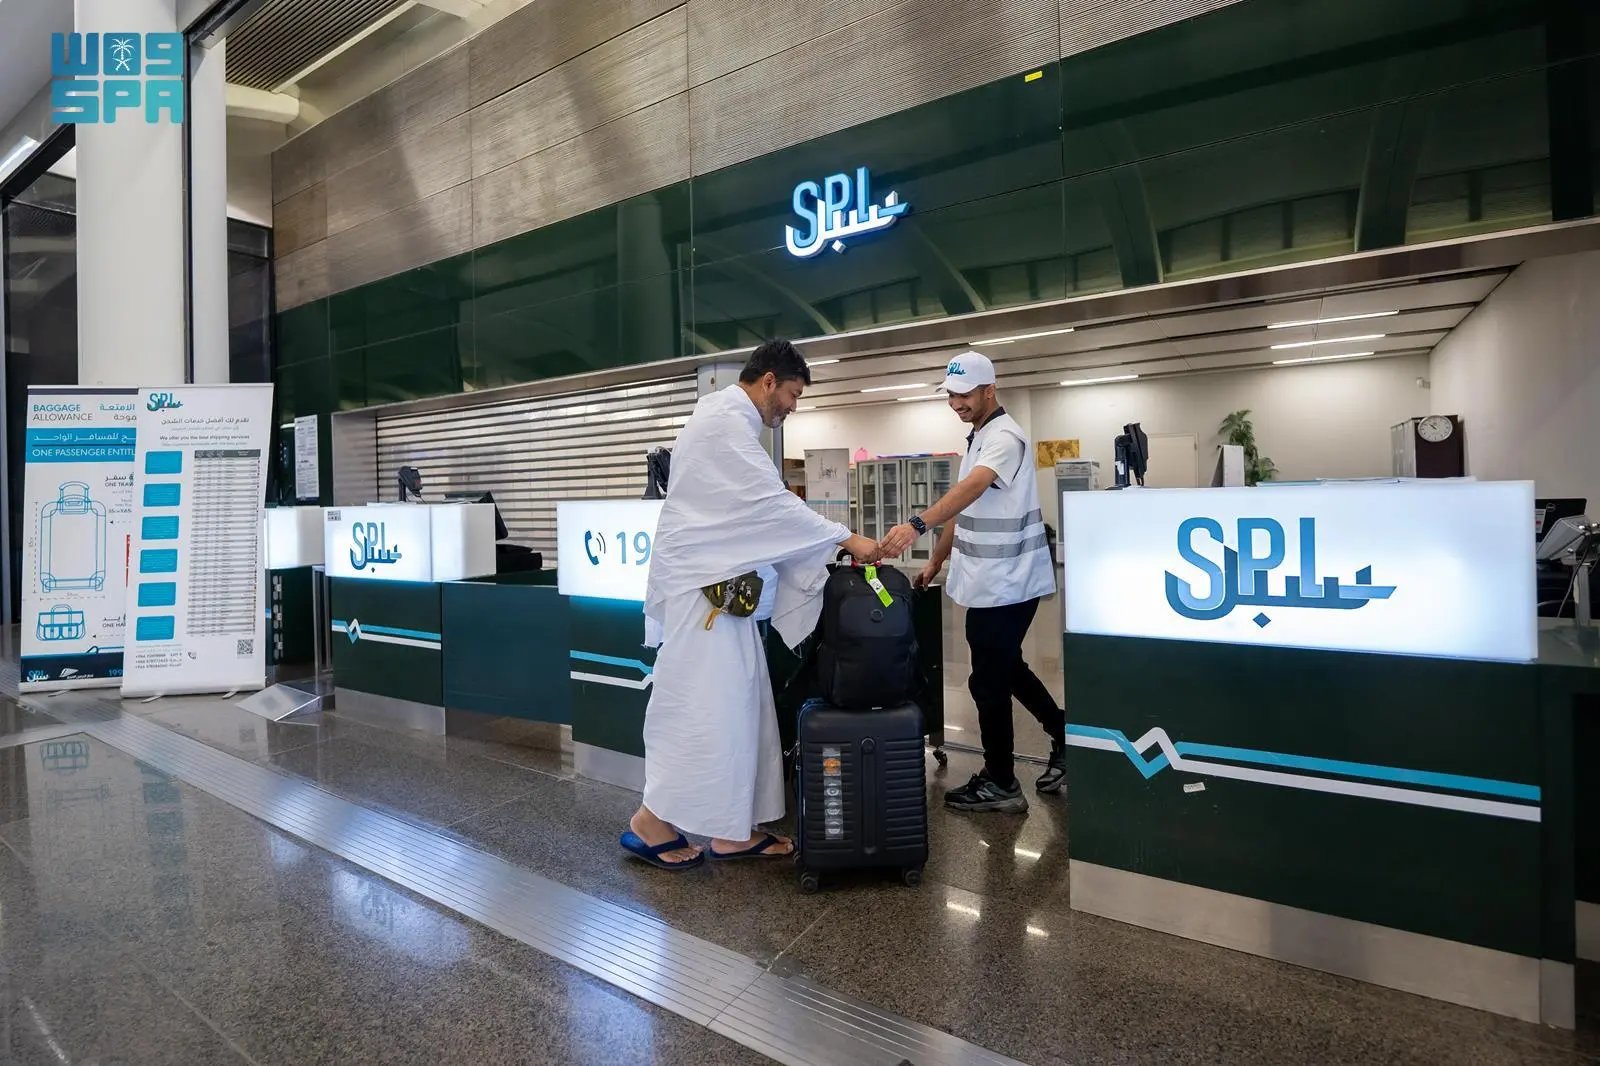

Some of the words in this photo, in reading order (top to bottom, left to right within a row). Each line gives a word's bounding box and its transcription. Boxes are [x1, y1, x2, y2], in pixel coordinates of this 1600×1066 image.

[792, 166, 909, 249] SPL
[32, 413, 93, 421] ALLOWANCE
[33, 404, 81, 412] BAGGAGE
[32, 449, 53, 457] ONE
[55, 448, 106, 456] PASSENGER
[352, 521, 402, 567] SPL
[616, 531, 652, 566] 19
[1176, 517, 1397, 610] SPL
